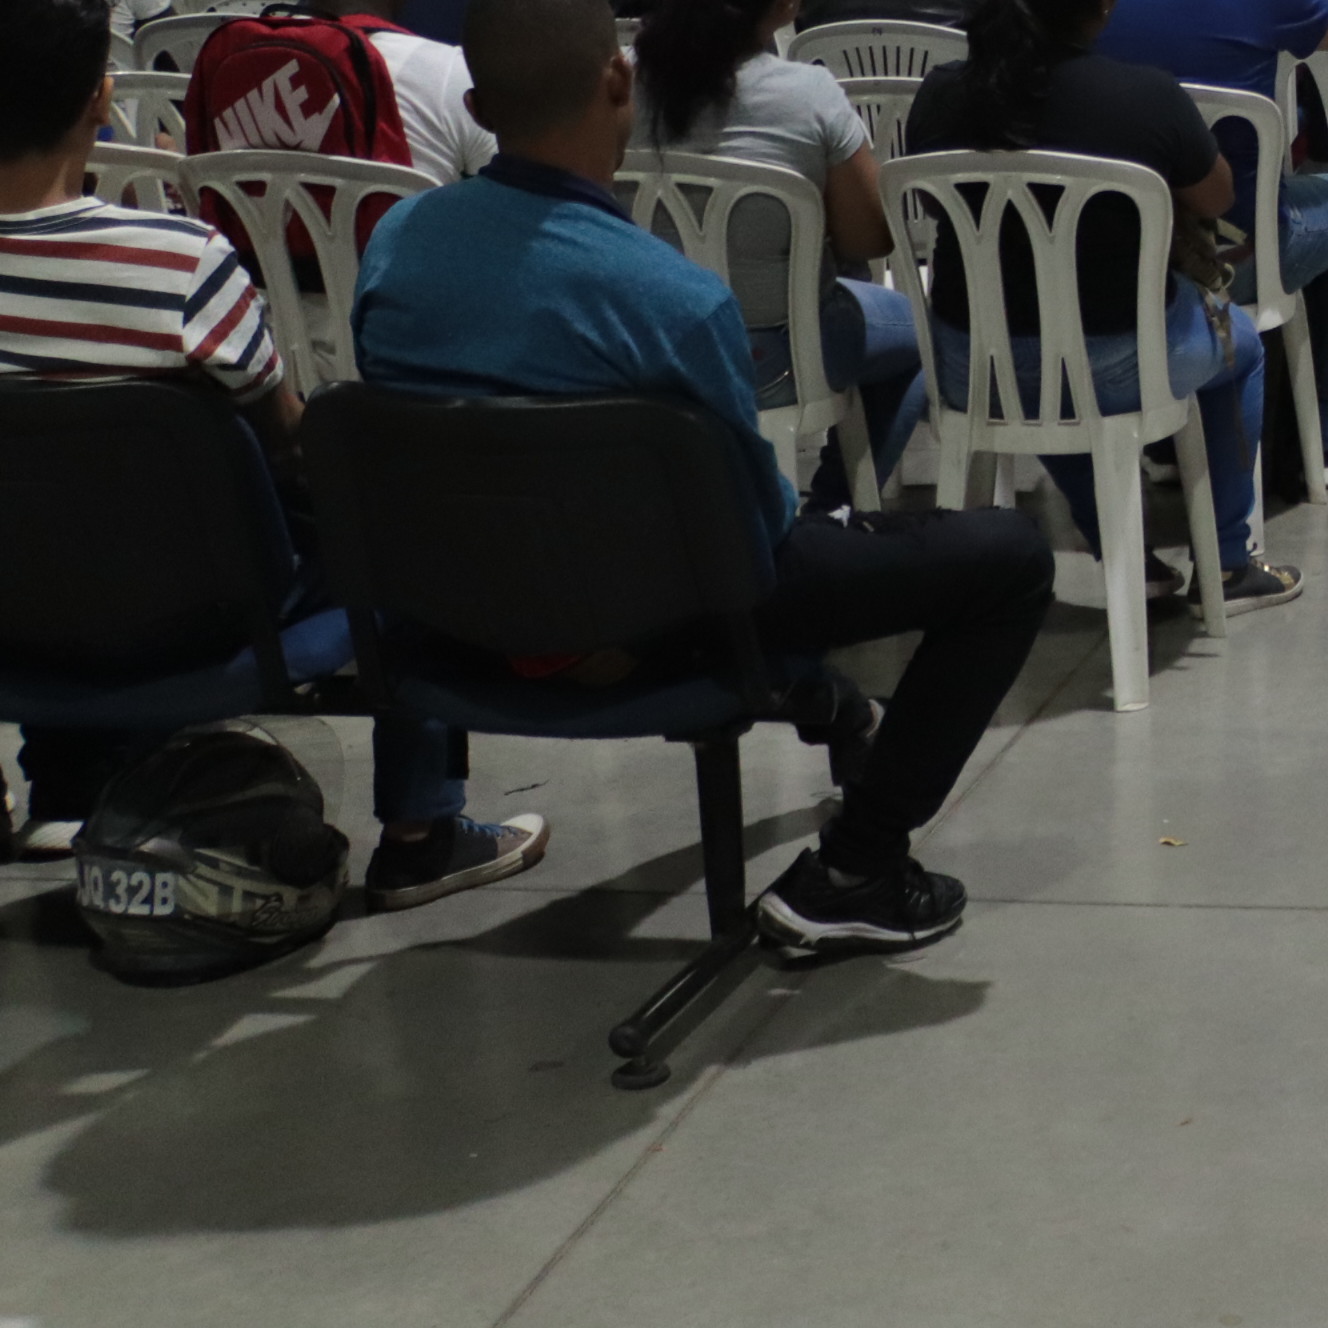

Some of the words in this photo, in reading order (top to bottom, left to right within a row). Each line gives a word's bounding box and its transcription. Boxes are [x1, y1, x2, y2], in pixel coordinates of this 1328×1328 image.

[213, 58, 319, 151] NIKE
[77, 864, 105, 909] JQ
[108, 869, 175, 915] 32B
